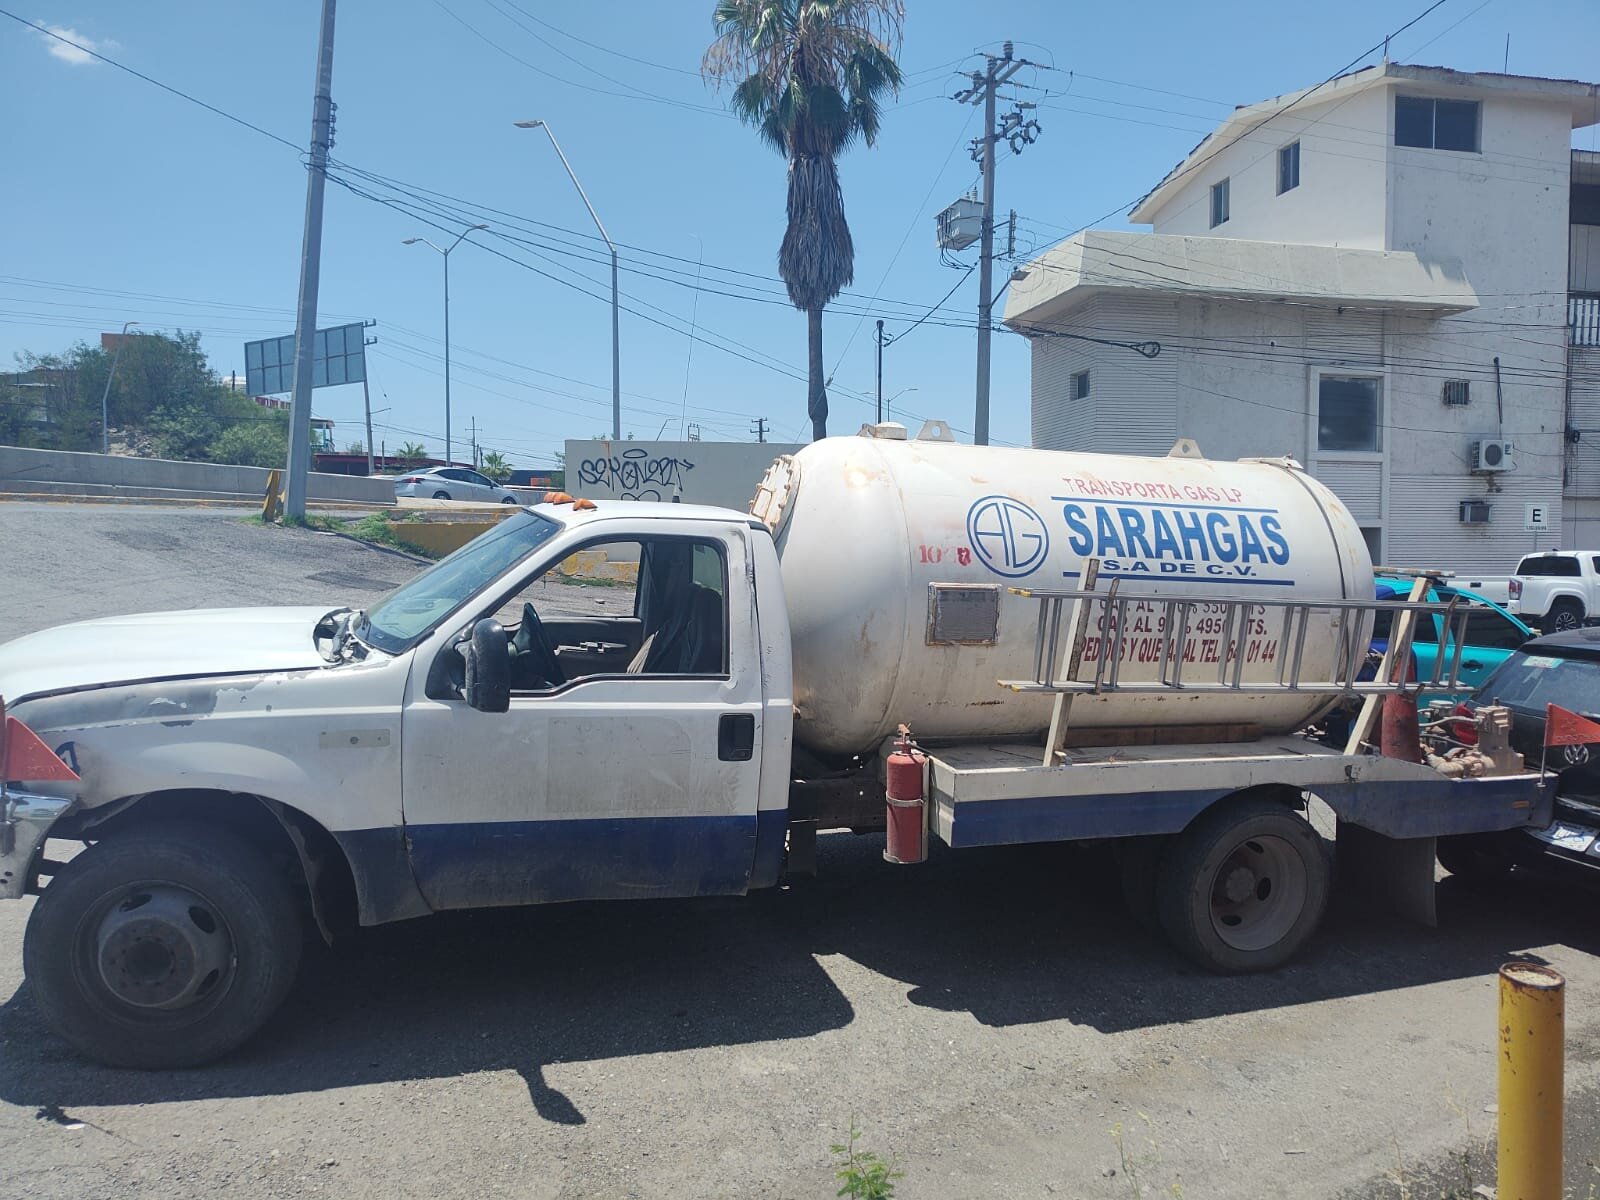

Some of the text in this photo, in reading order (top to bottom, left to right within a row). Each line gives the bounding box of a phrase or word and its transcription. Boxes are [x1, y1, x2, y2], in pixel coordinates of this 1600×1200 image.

[1063, 477, 1243, 503] TRANSPORTA GAS LP
[1532, 508, 1542, 523] E
[1063, 503, 1290, 566] SARAHGAS
[1103, 559, 1257, 577] S.A DE C.V.
[1133, 615, 1153, 633] AL
[1196, 618, 1232, 634] 495
[1129, 637, 1139, 662] Y
[1182, 639, 1197, 663] AL
[1200, 639, 1220, 663] TEL.
